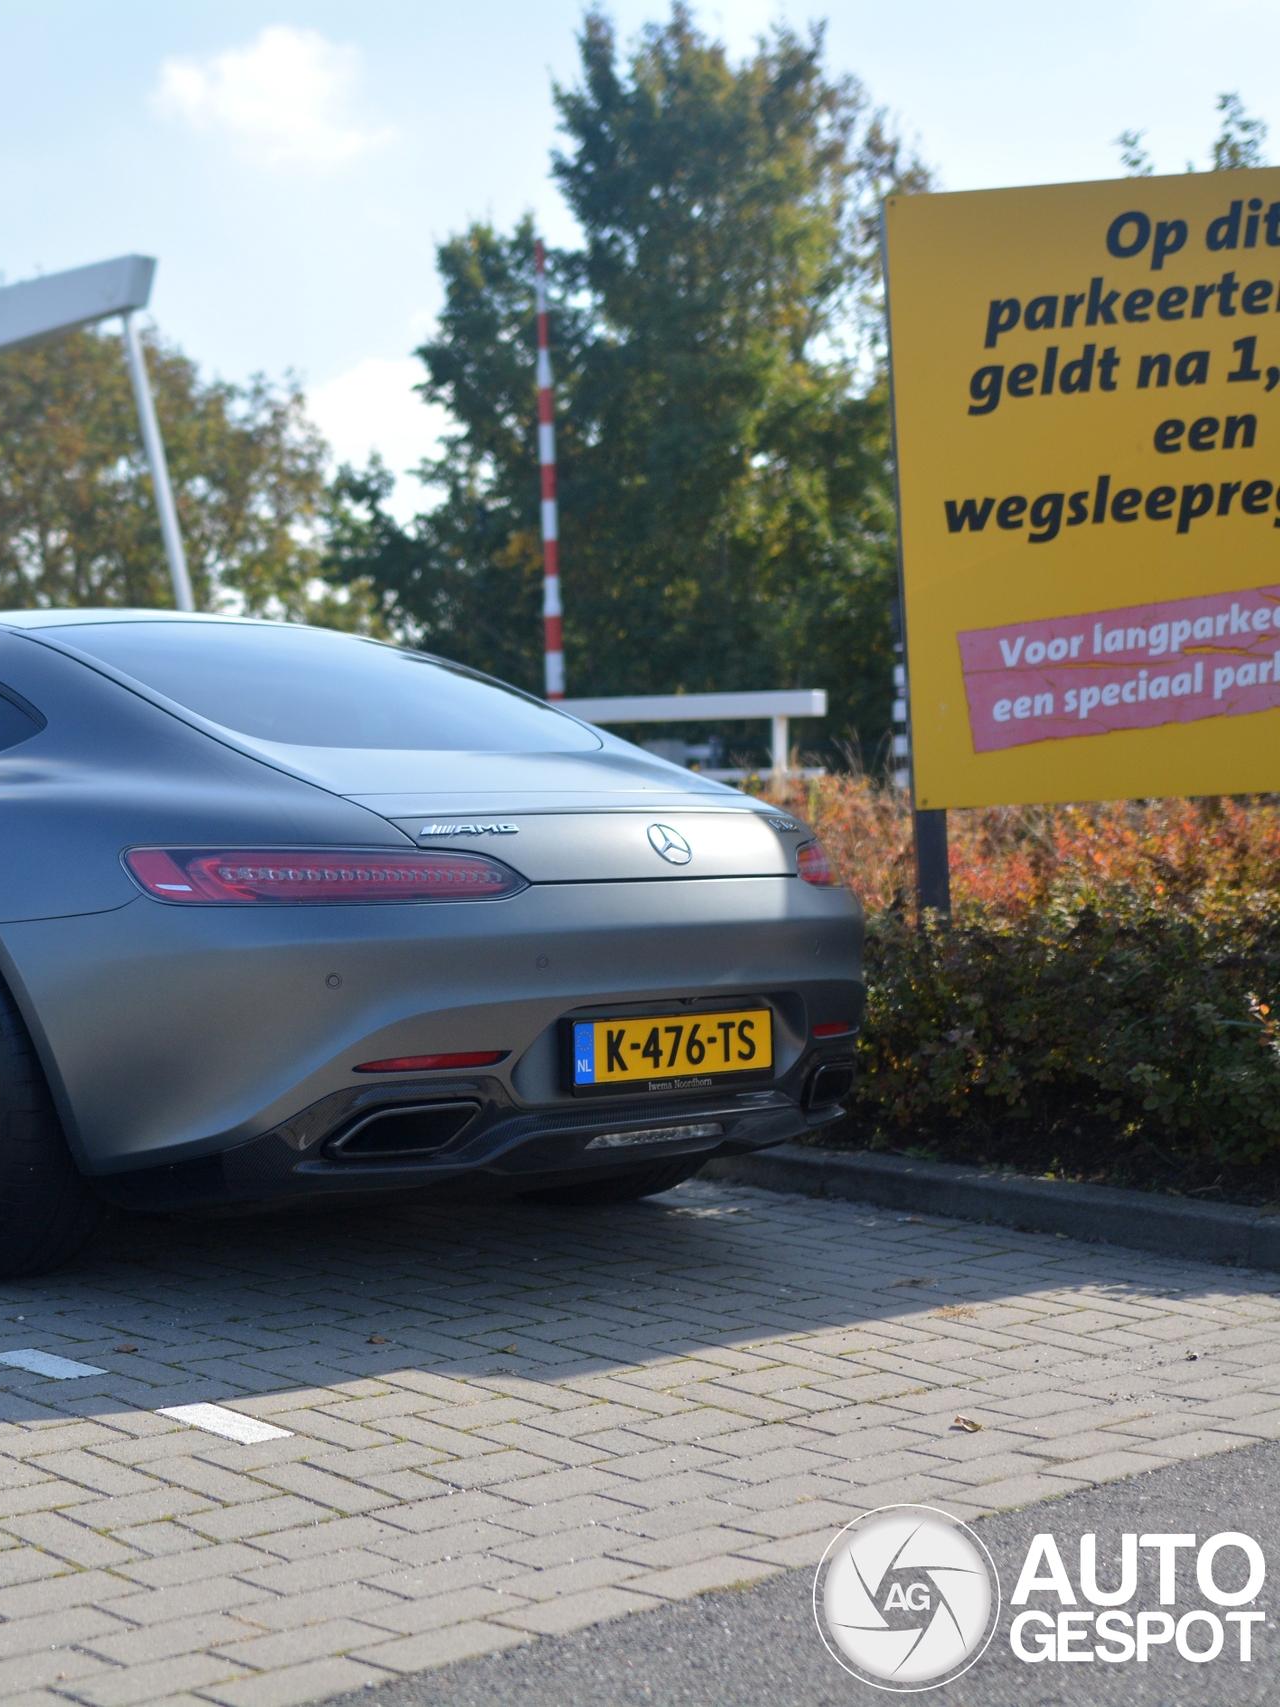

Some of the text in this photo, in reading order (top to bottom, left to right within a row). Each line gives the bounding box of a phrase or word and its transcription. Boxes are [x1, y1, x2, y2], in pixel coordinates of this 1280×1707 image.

[1106, 198, 1280, 270] Op dit
[984, 270, 1280, 349] parkeerte
[967, 343, 1120, 416] geldt
[1136, 350, 1210, 389] na
[1153, 413, 1257, 454] een
[944, 474, 1280, 544] wegsleepre
[998, 634, 1084, 669] Voor
[992, 690, 1055, 724] een
[1063, 660, 1204, 720] speciaal
[453, 824, 519, 835] AMG
[576, 1059, 592, 1073] NL
[606, 1019, 756, 1073] K-476-TS
